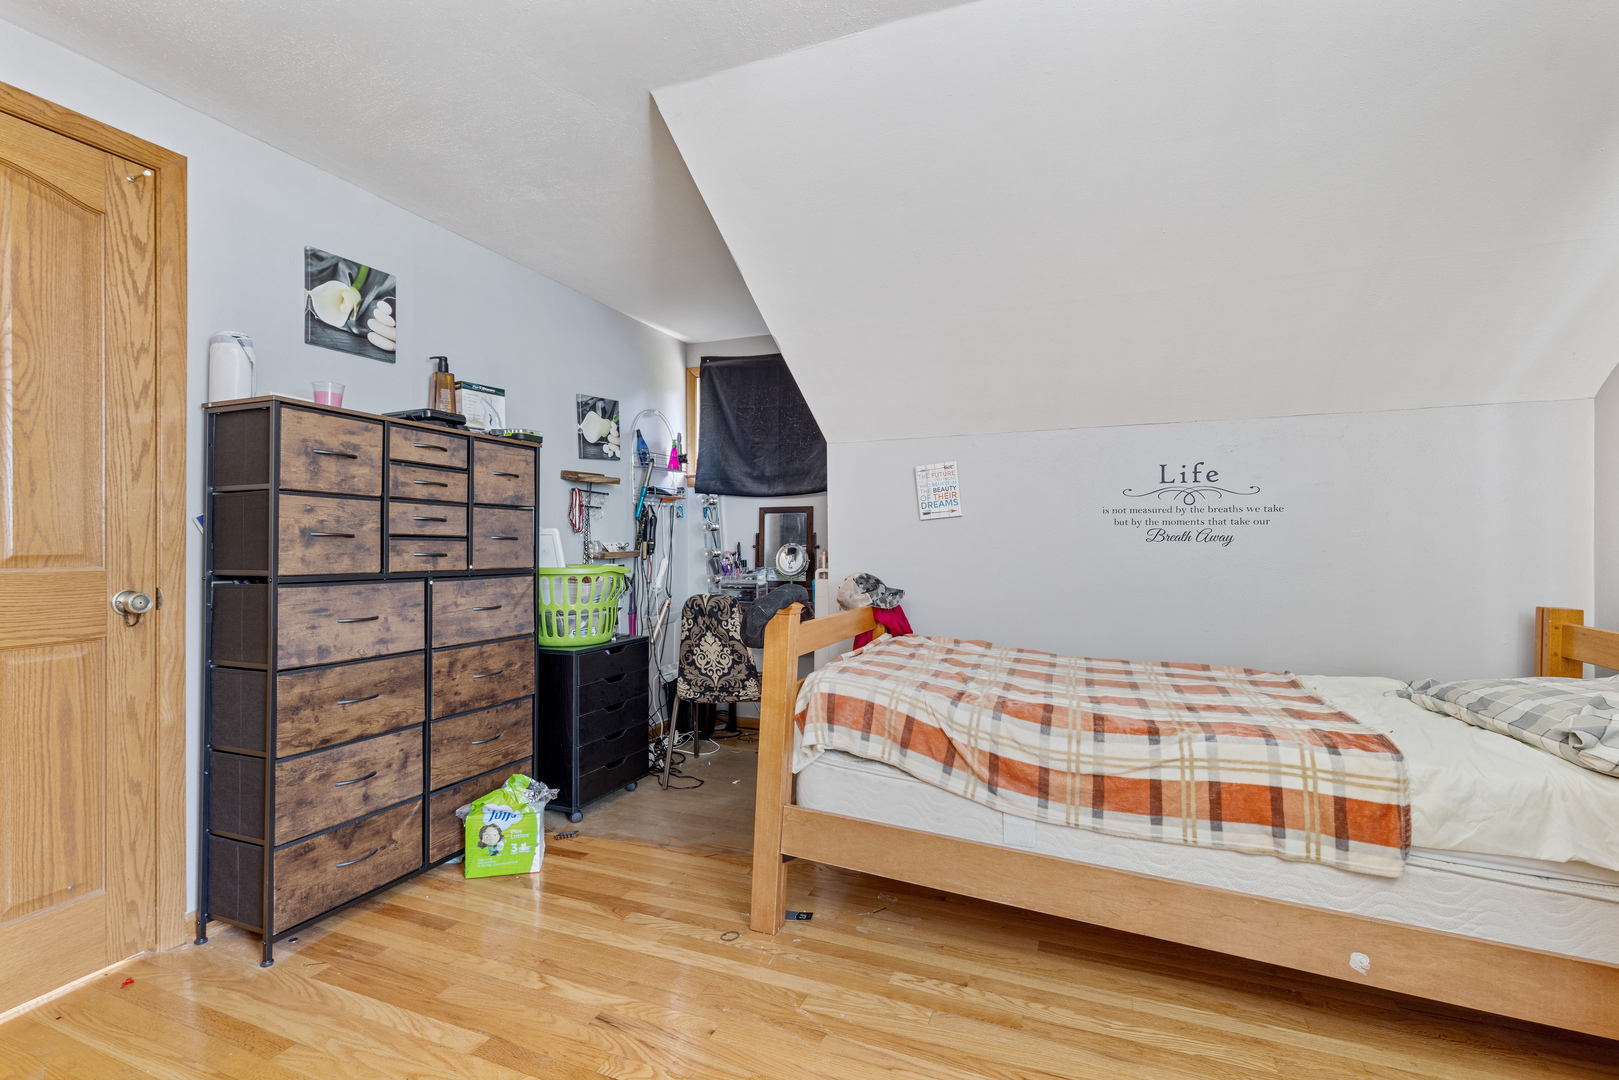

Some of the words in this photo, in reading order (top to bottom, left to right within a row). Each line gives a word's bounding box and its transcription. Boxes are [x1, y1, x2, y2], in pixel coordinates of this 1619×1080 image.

[931, 470, 955, 478] FUTURE
[1159, 462, 1219, 484] Life
[933, 491, 957, 500] THEIR
[921, 499, 958, 509] DREAMS
[1102, 506, 1109, 514] is
[1129, 505, 1173, 514] measured
[1175, 505, 1187, 516] by
[1190, 505, 1205, 513] the
[1207, 504, 1243, 513] breaths
[1263, 504, 1284, 513] take
[1113, 518, 1128, 526] but
[1131, 518, 1142, 528] by
[1145, 518, 1159, 526] the
[1162, 518, 1205, 526] moments
[1208, 517, 1227, 526] that
[1230, 517, 1250, 526] take
[1145, 527, 1193, 543] Breath
[1195, 527, 1235, 547] Away
[511, 843, 518, 853] 3
